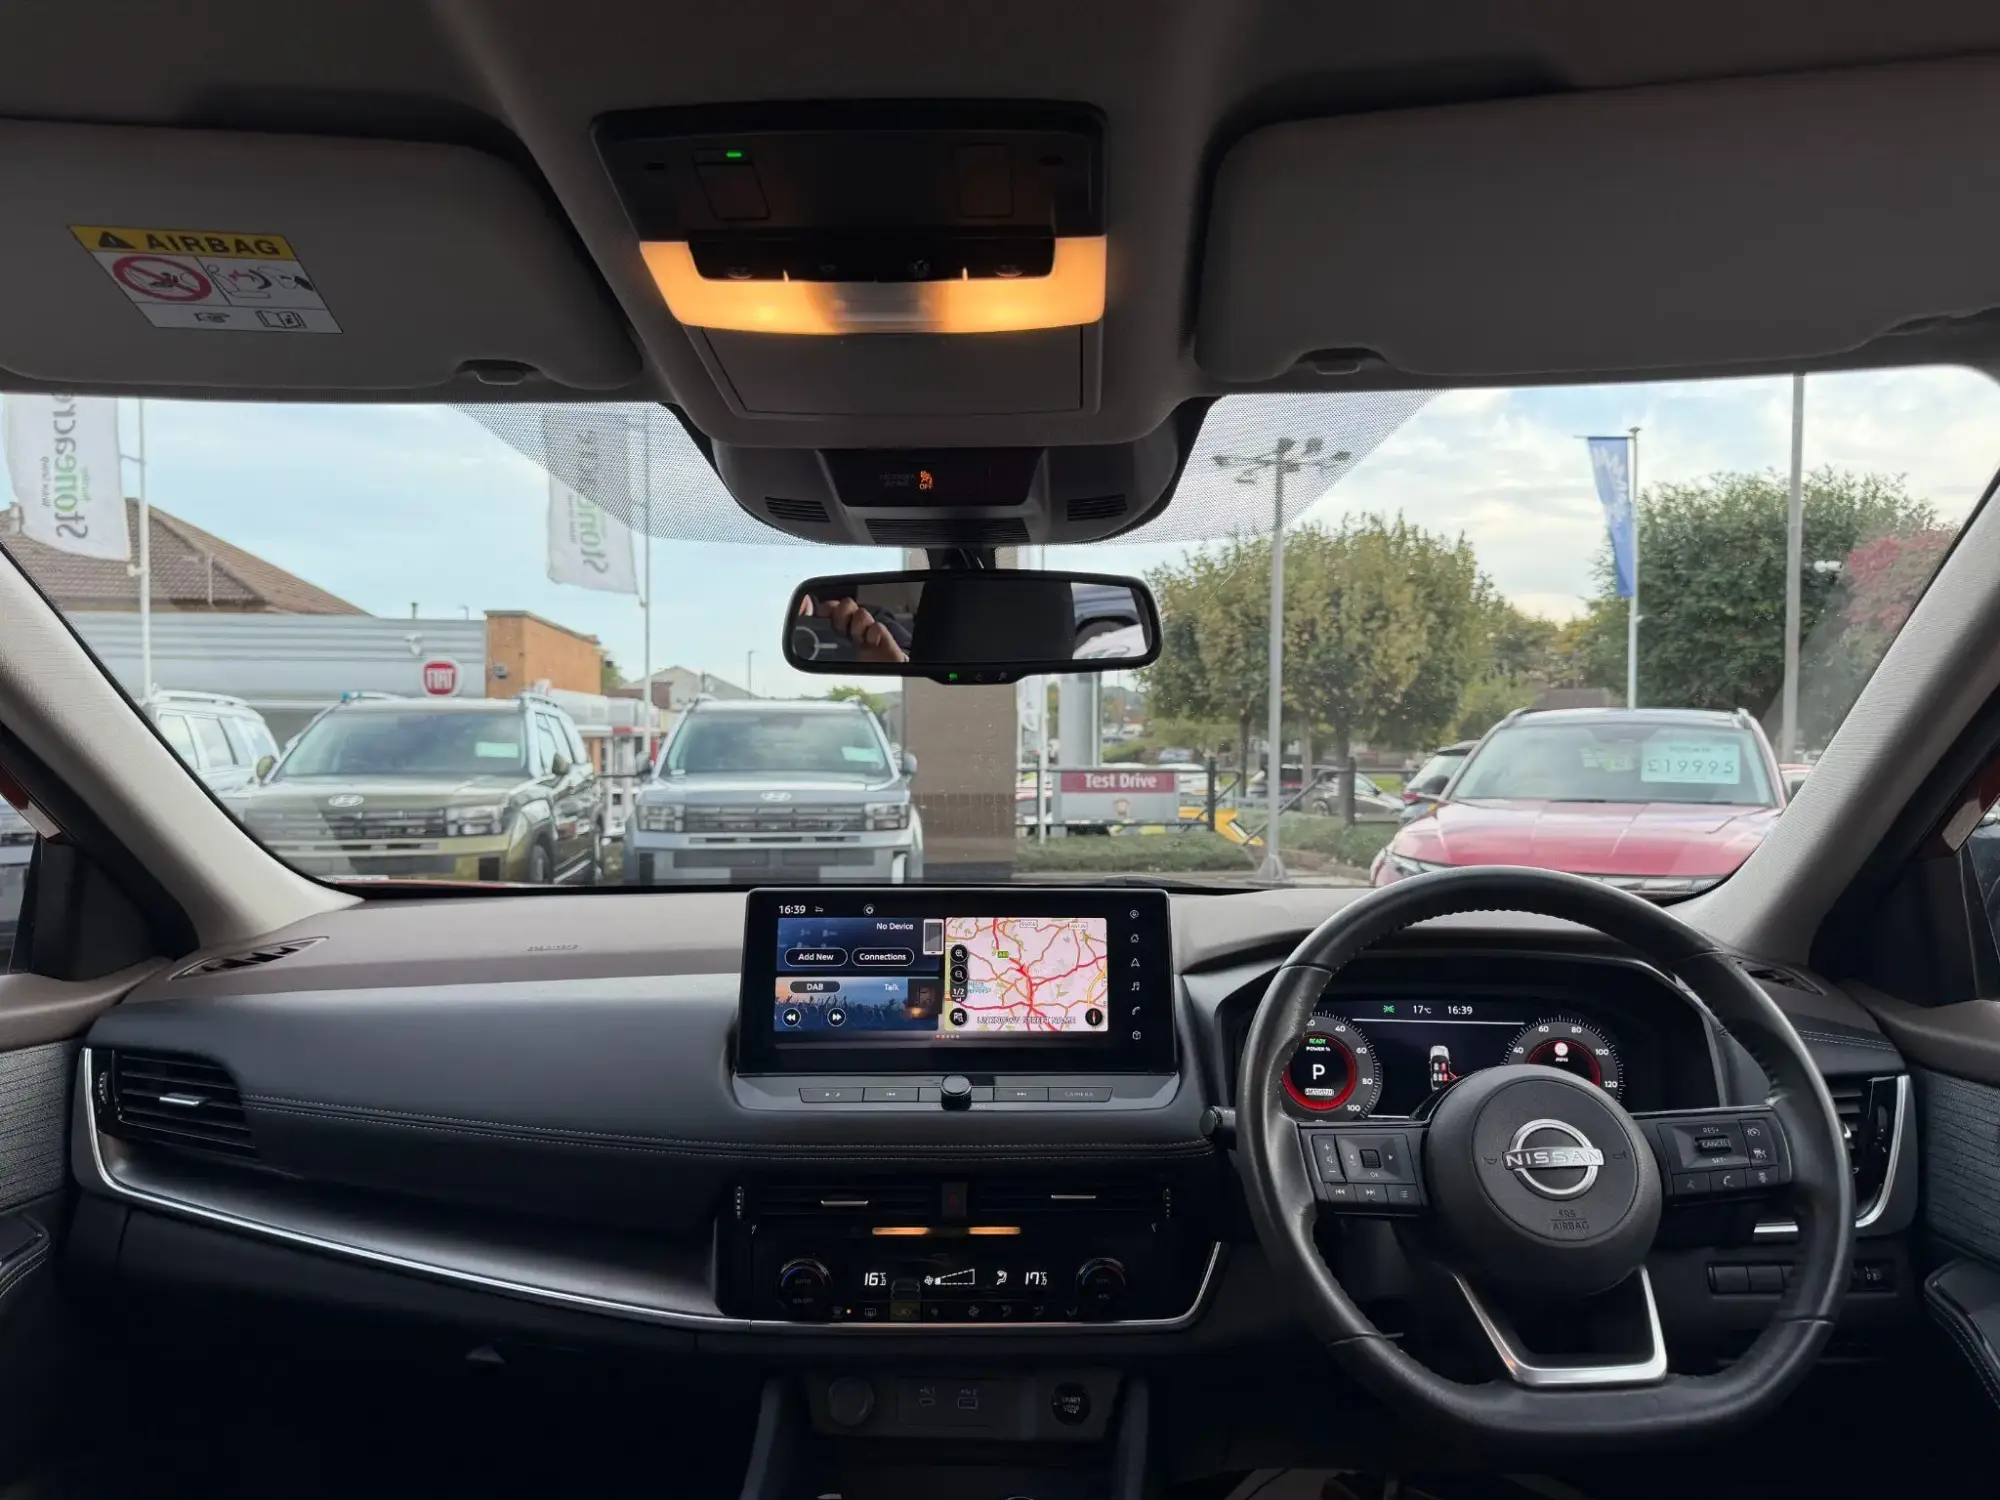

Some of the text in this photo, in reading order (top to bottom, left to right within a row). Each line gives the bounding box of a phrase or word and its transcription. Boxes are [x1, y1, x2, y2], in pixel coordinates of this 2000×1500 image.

[146, 234, 281, 255] AIRBAG
[1084, 773, 1157, 788] Test Drive
[778, 904, 806, 914] 16:39
[876, 922, 914, 930] No Device
[798, 953, 834, 961] Add New
[859, 953, 906, 961] Connections
[806, 983, 824, 991] DAB
[884, 983, 899, 991] Talk
[1447, 1005, 1473, 1015] 16:39
[1335, 1025, 1346, 1033] 40
[1538, 1025, 1550, 1033] 60
[1571, 1026, 1582, 1034] 80
[1513, 1046, 1524, 1054] 40
[1595, 1048, 1609, 1056] 100
[1312, 1064, 1325, 1080] P
[1604, 1081, 1618, 1089] 120
[1505, 1150, 1603, 1167] NISSAN
